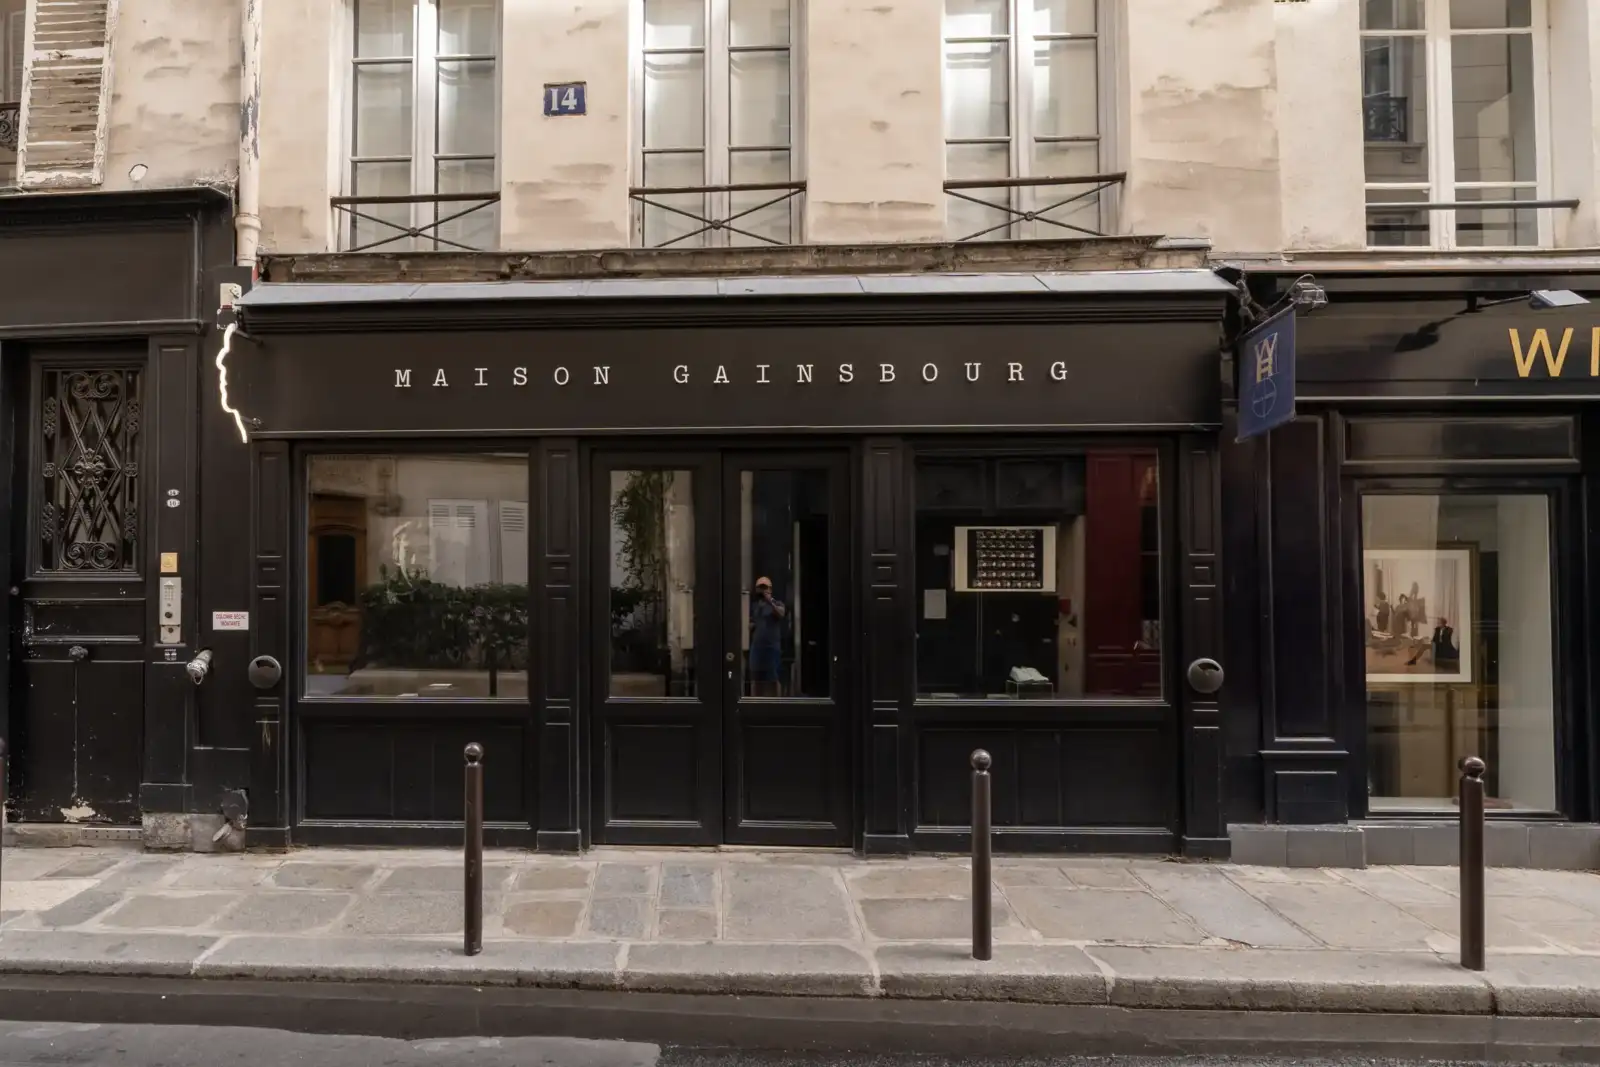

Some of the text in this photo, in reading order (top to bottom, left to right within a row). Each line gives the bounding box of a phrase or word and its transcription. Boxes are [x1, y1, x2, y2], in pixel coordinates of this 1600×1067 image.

[550, 87, 578, 111] 14
[394, 361, 1069, 388] MAISON GAINSBOURG
